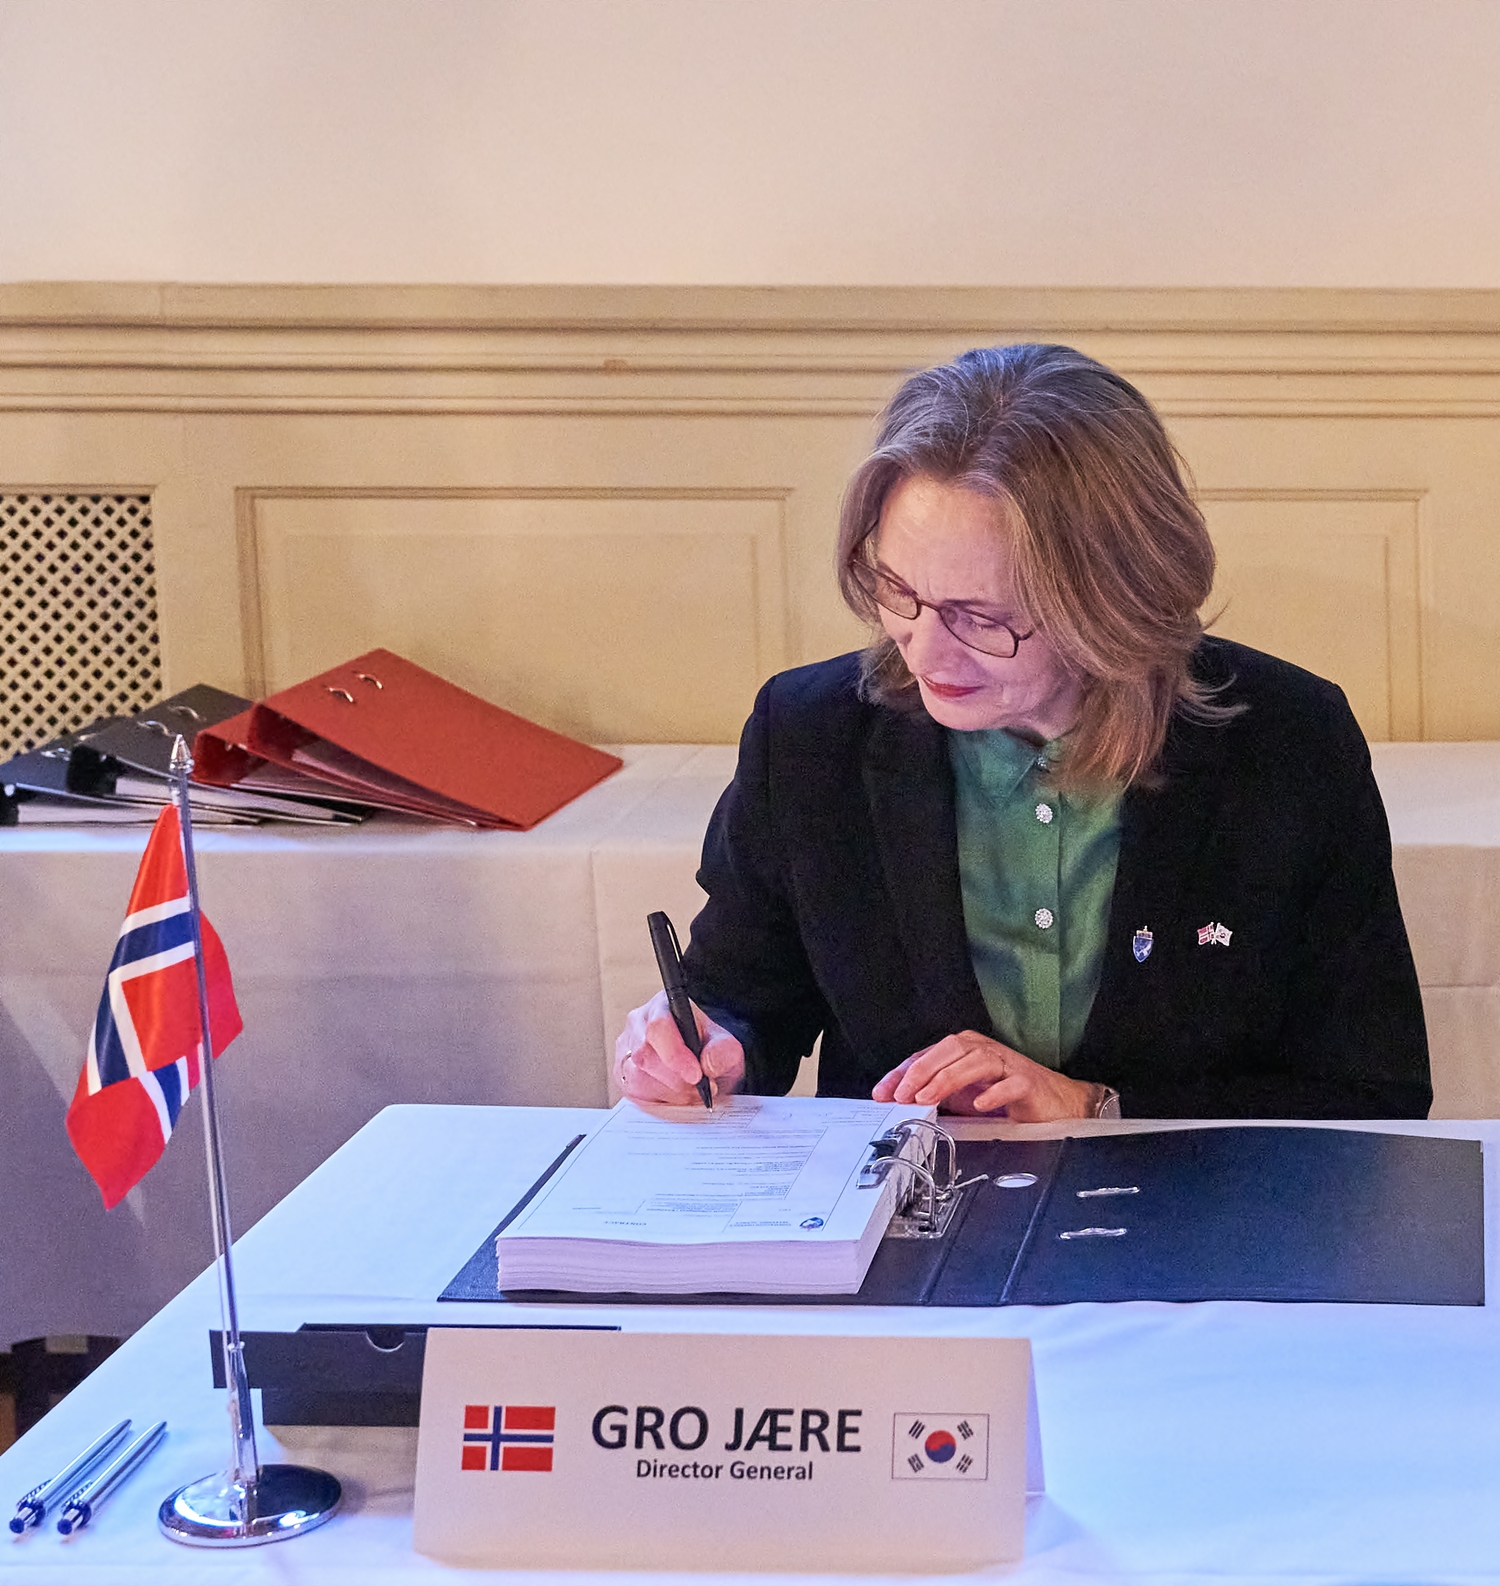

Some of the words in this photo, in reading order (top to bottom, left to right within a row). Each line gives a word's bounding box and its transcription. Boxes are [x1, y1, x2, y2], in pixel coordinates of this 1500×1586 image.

[592, 1405, 708, 1450] GRO
[724, 1407, 862, 1452] JÆRE
[637, 1459, 723, 1478] Director
[730, 1461, 813, 1480] General
